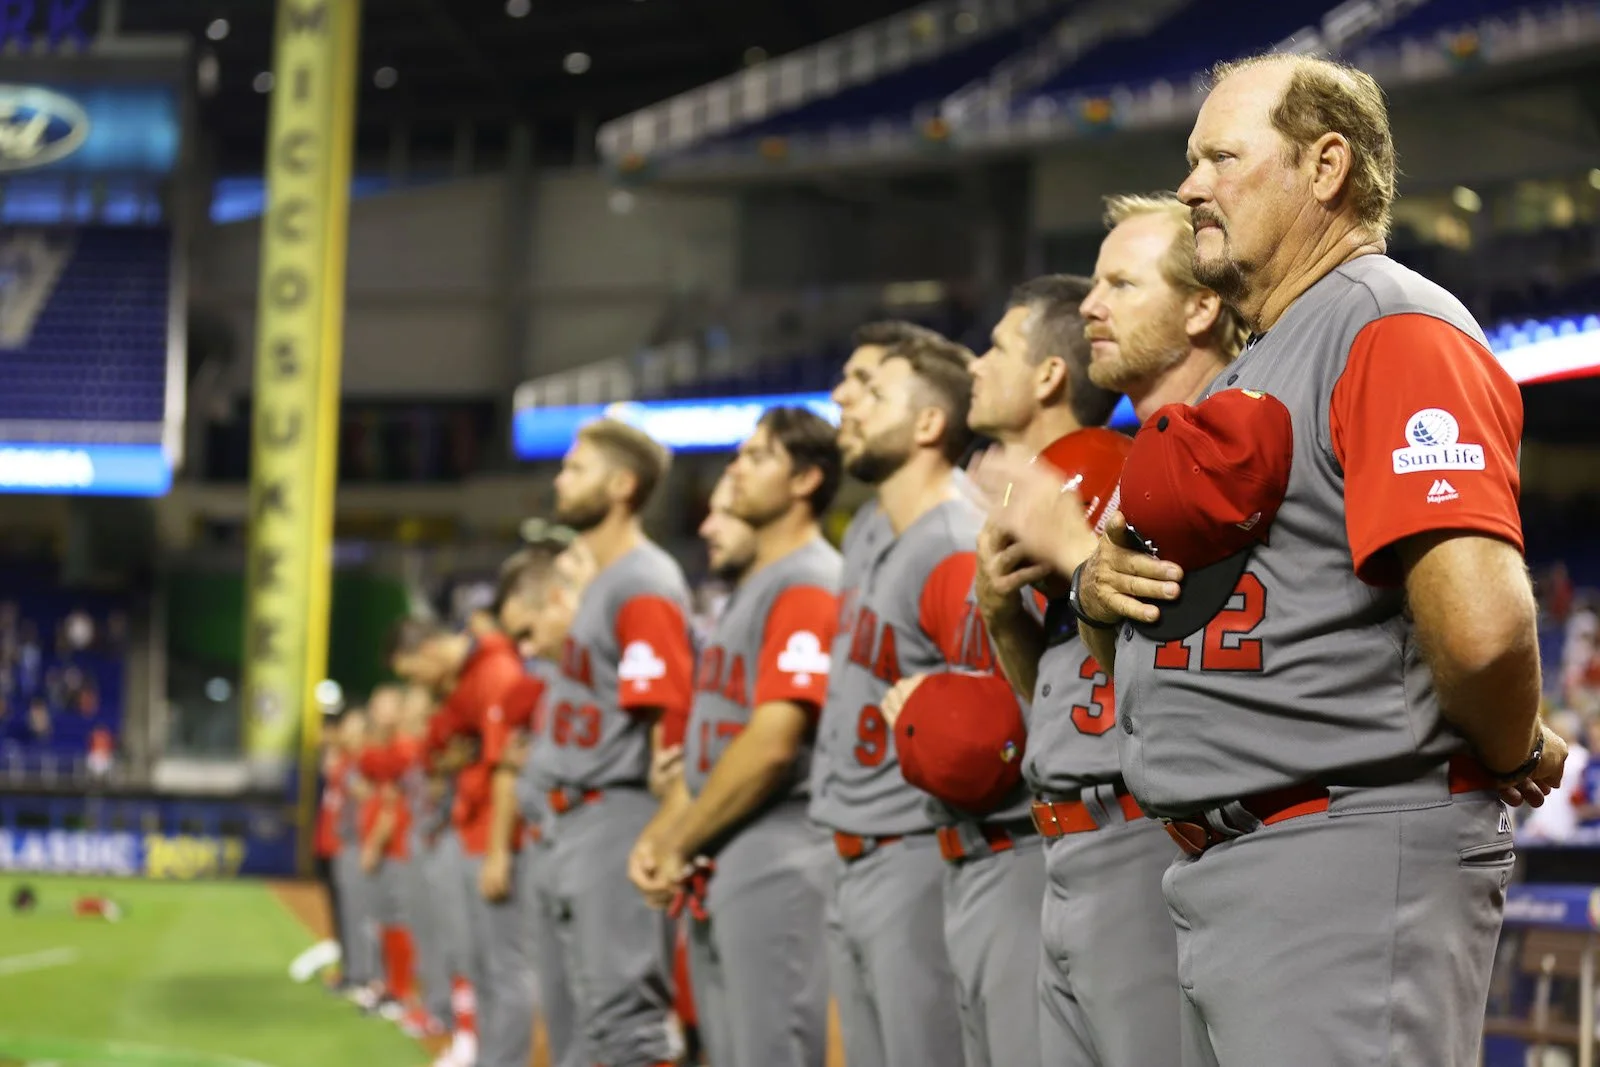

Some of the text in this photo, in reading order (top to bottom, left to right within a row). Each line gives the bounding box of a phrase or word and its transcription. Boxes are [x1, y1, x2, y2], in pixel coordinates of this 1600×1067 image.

[1398, 449, 1479, 468] Sun Life
[554, 700, 602, 750] 63
[854, 704, 888, 767] 9
